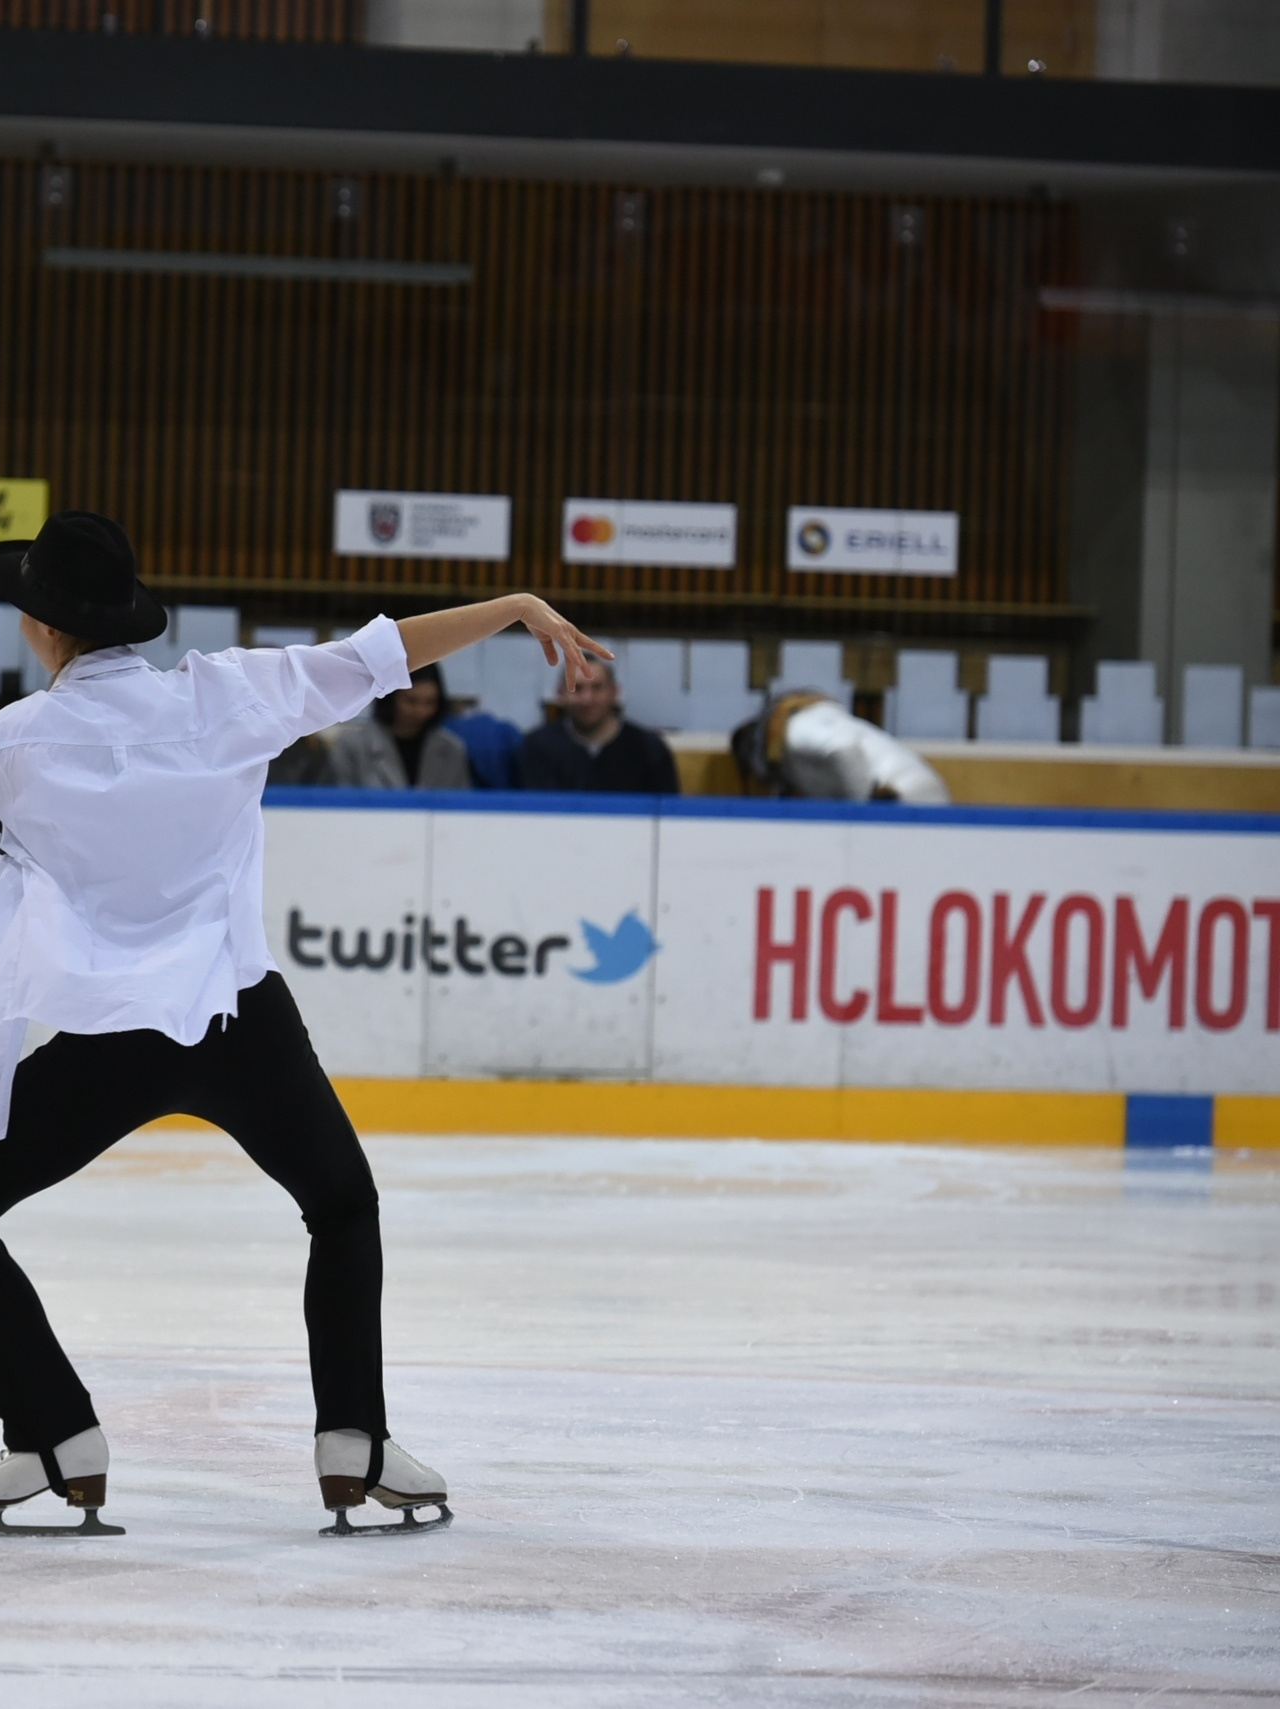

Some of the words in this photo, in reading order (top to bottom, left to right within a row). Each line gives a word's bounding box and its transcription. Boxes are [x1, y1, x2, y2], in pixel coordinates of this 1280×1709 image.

[846, 529, 949, 555] ERIELL
[287, 908, 571, 976] twitter
[753, 887, 1280, 1032] HCLOKOMOT
